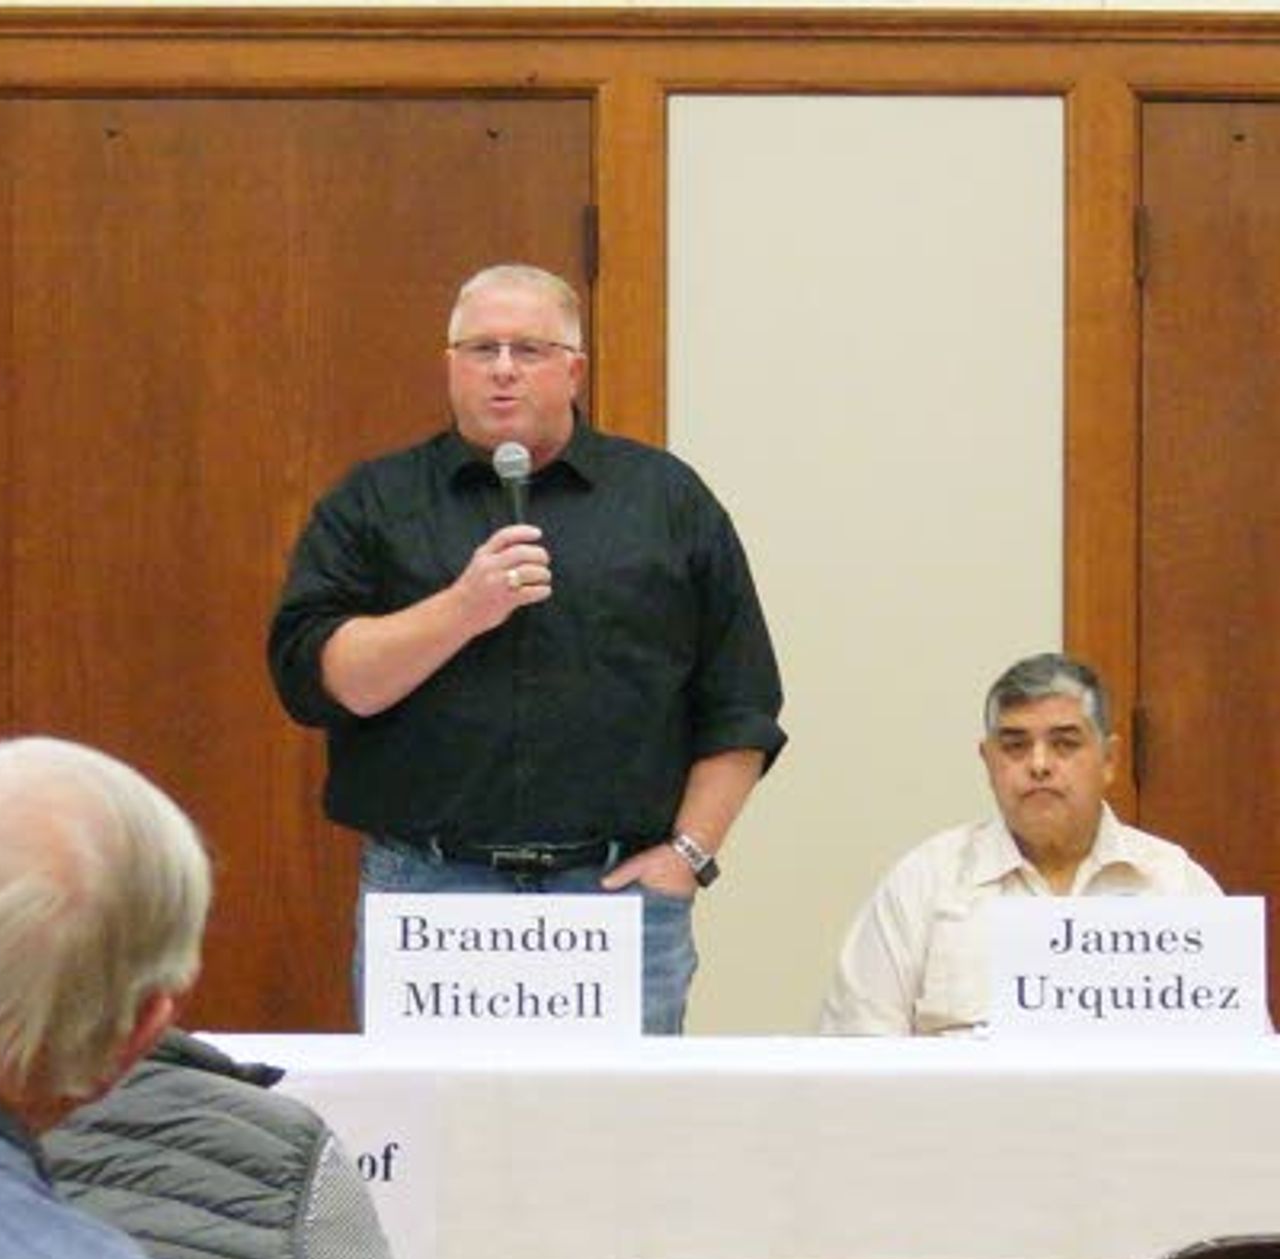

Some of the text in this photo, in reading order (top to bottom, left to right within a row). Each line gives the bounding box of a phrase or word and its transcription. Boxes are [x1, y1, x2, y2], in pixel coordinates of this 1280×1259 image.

[399, 915, 610, 953] Brandon
[1049, 918, 1203, 955] James
[403, 981, 603, 1018] Mitchell
[1015, 975, 1241, 1018] Urquidez
[357, 1142, 399, 1182] of
